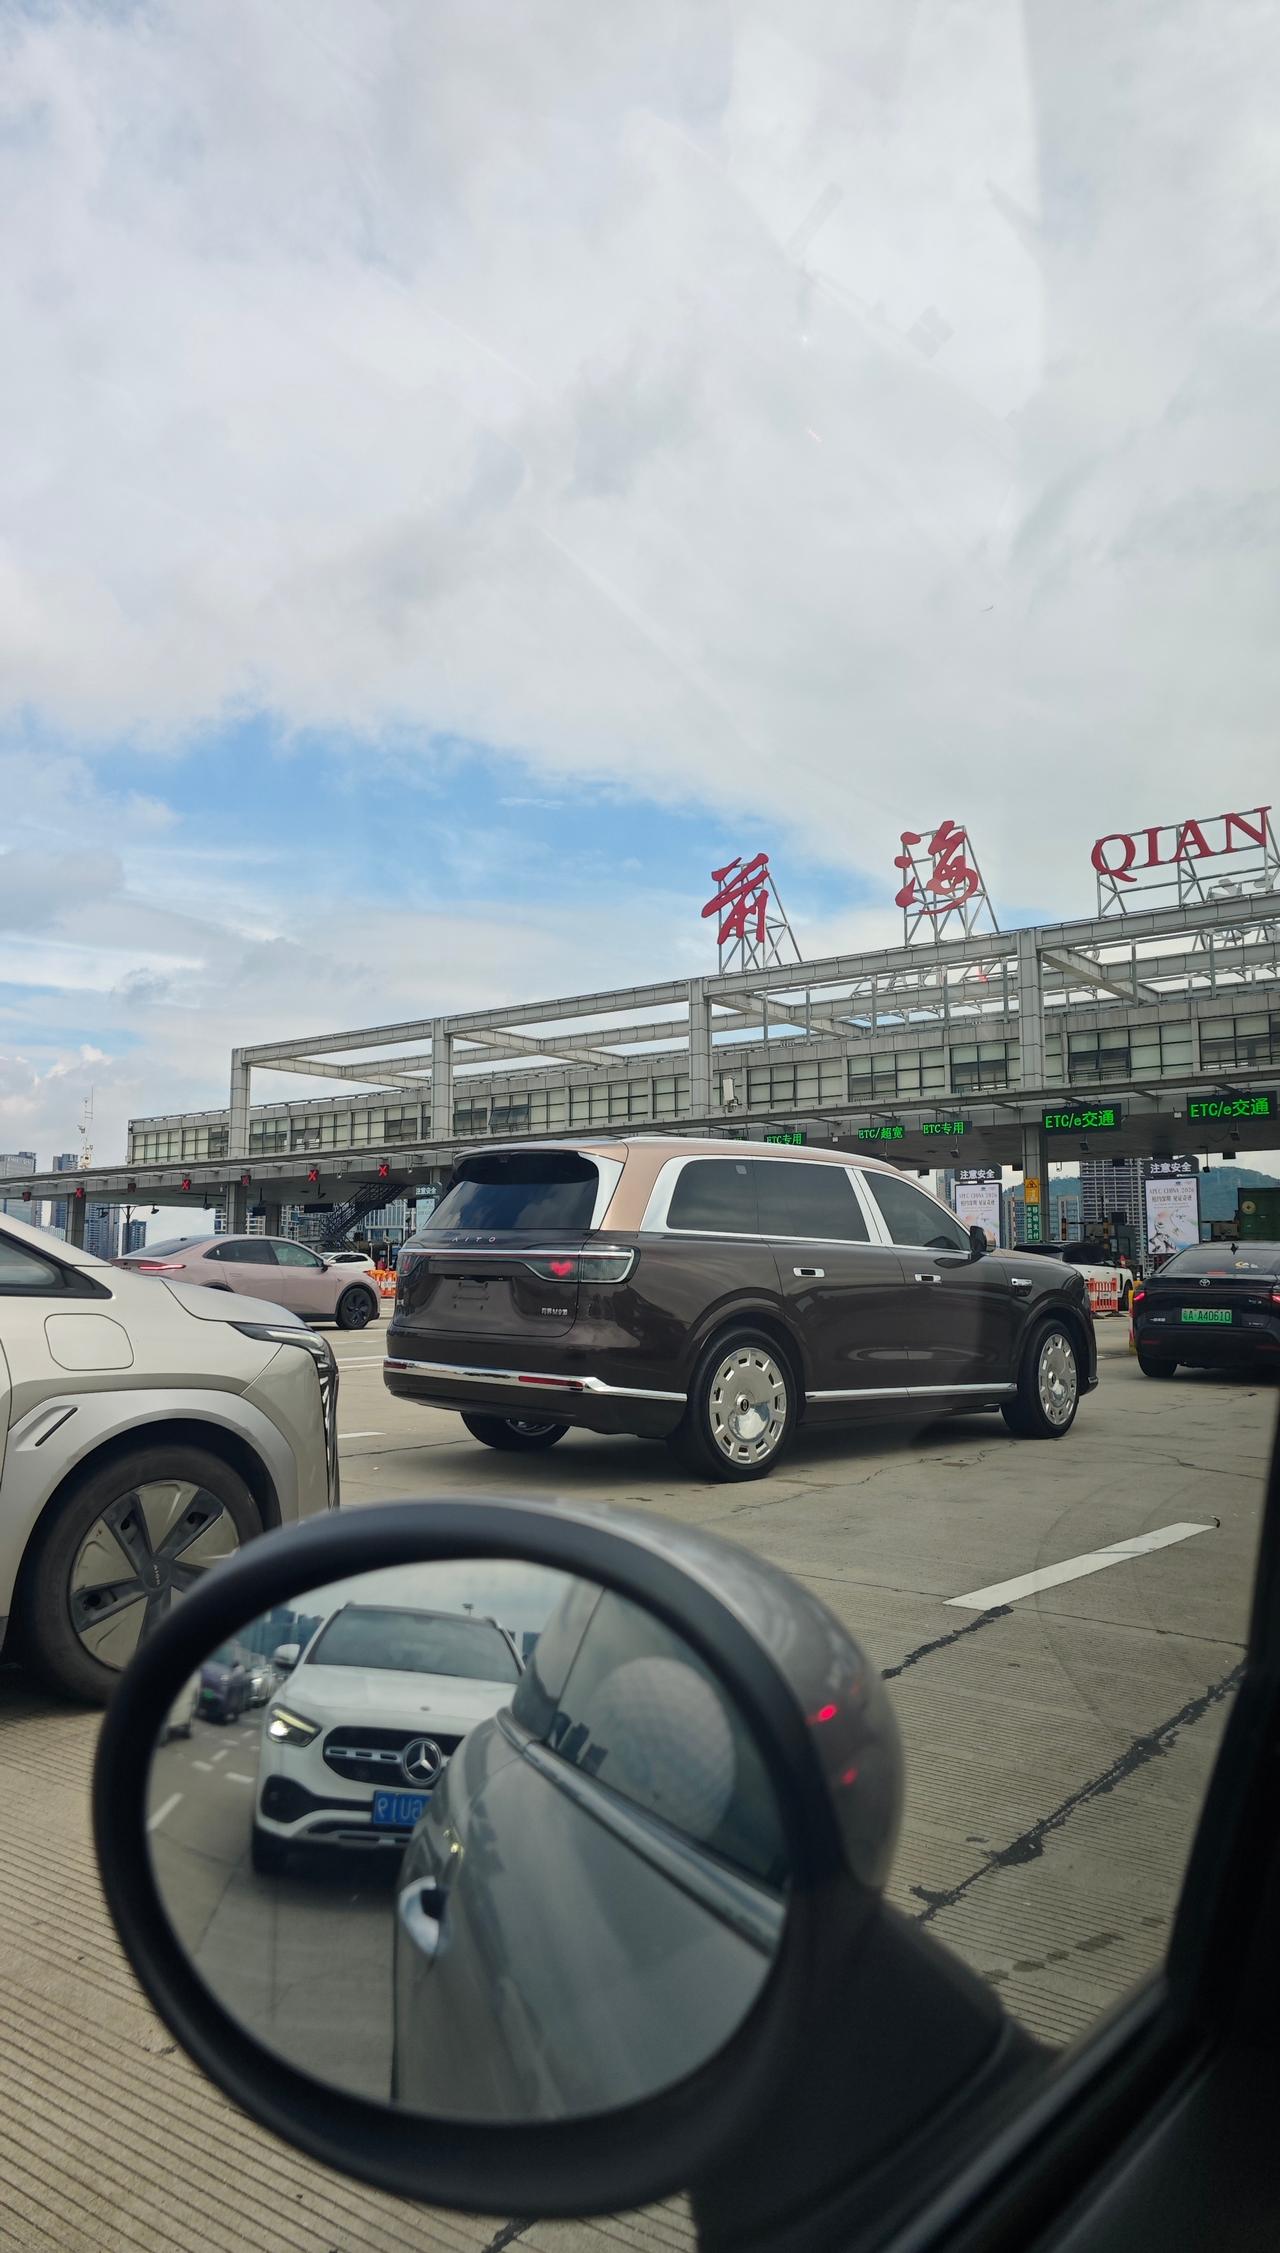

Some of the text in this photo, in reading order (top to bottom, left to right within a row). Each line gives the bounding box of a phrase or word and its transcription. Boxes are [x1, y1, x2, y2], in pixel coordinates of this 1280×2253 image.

[1091, 806, 1272, 882] QIAN
[1190, 1098, 1270, 1118] ETC/e交通
[1045, 1110, 1115, 1129] ETC/e交通
[922, 1121, 964, 1135] ETC专用
[960, 1169, 995, 1179] 注意安全
[1150, 1162, 1192, 1174] 注意安全
